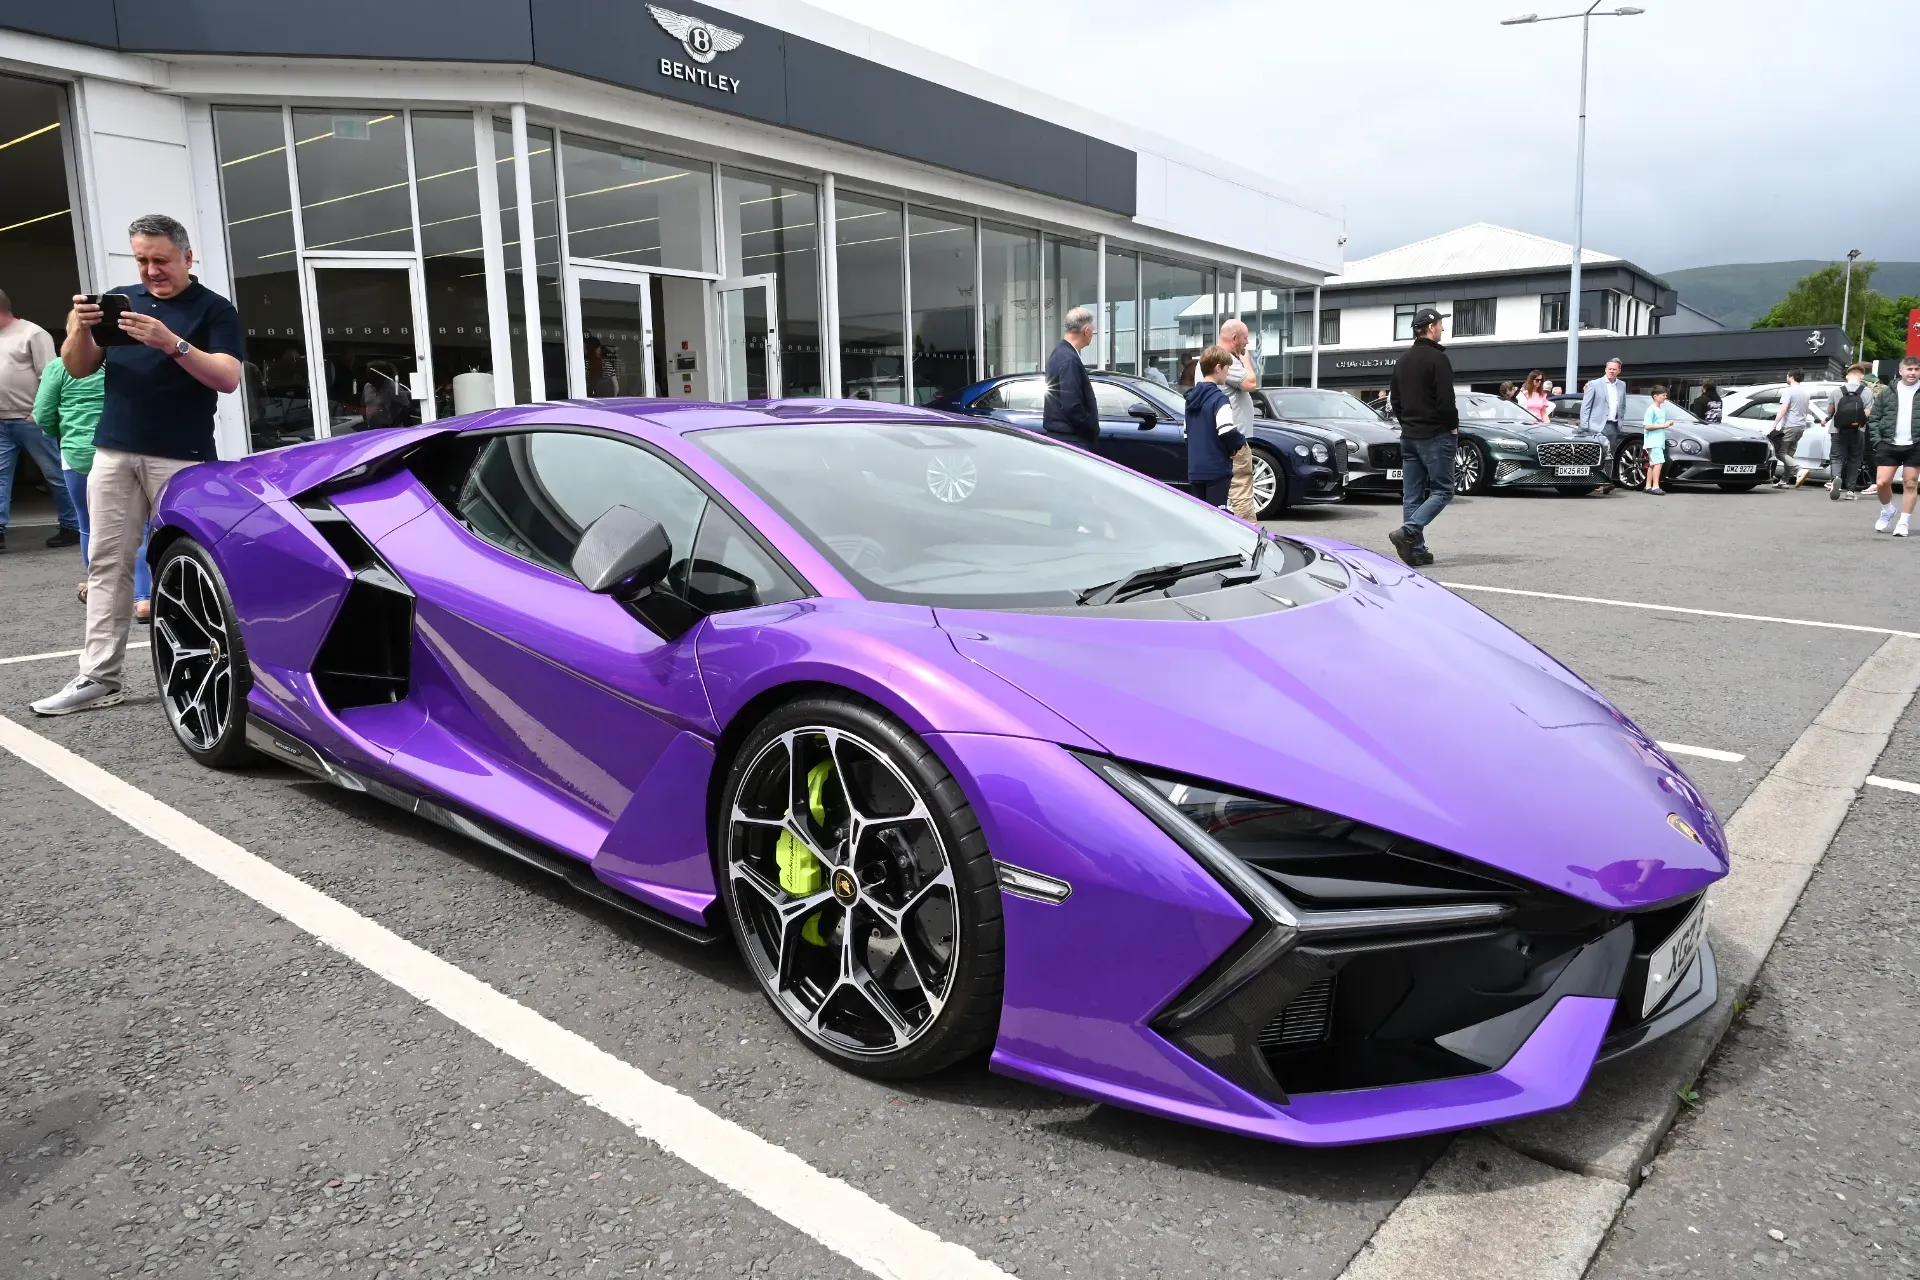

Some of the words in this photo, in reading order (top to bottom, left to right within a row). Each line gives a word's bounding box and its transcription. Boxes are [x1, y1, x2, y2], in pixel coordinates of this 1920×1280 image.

[693, 28, 710, 52] B
[660, 58, 740, 94] BENTLEY
[1335, 359, 1379, 369] CHARLES
[1559, 467, 1576, 475] DK25
[1726, 465, 1739, 473] DMZ
[1739, 465, 1754, 473] 9272
[1391, 470, 1404, 479] GB
